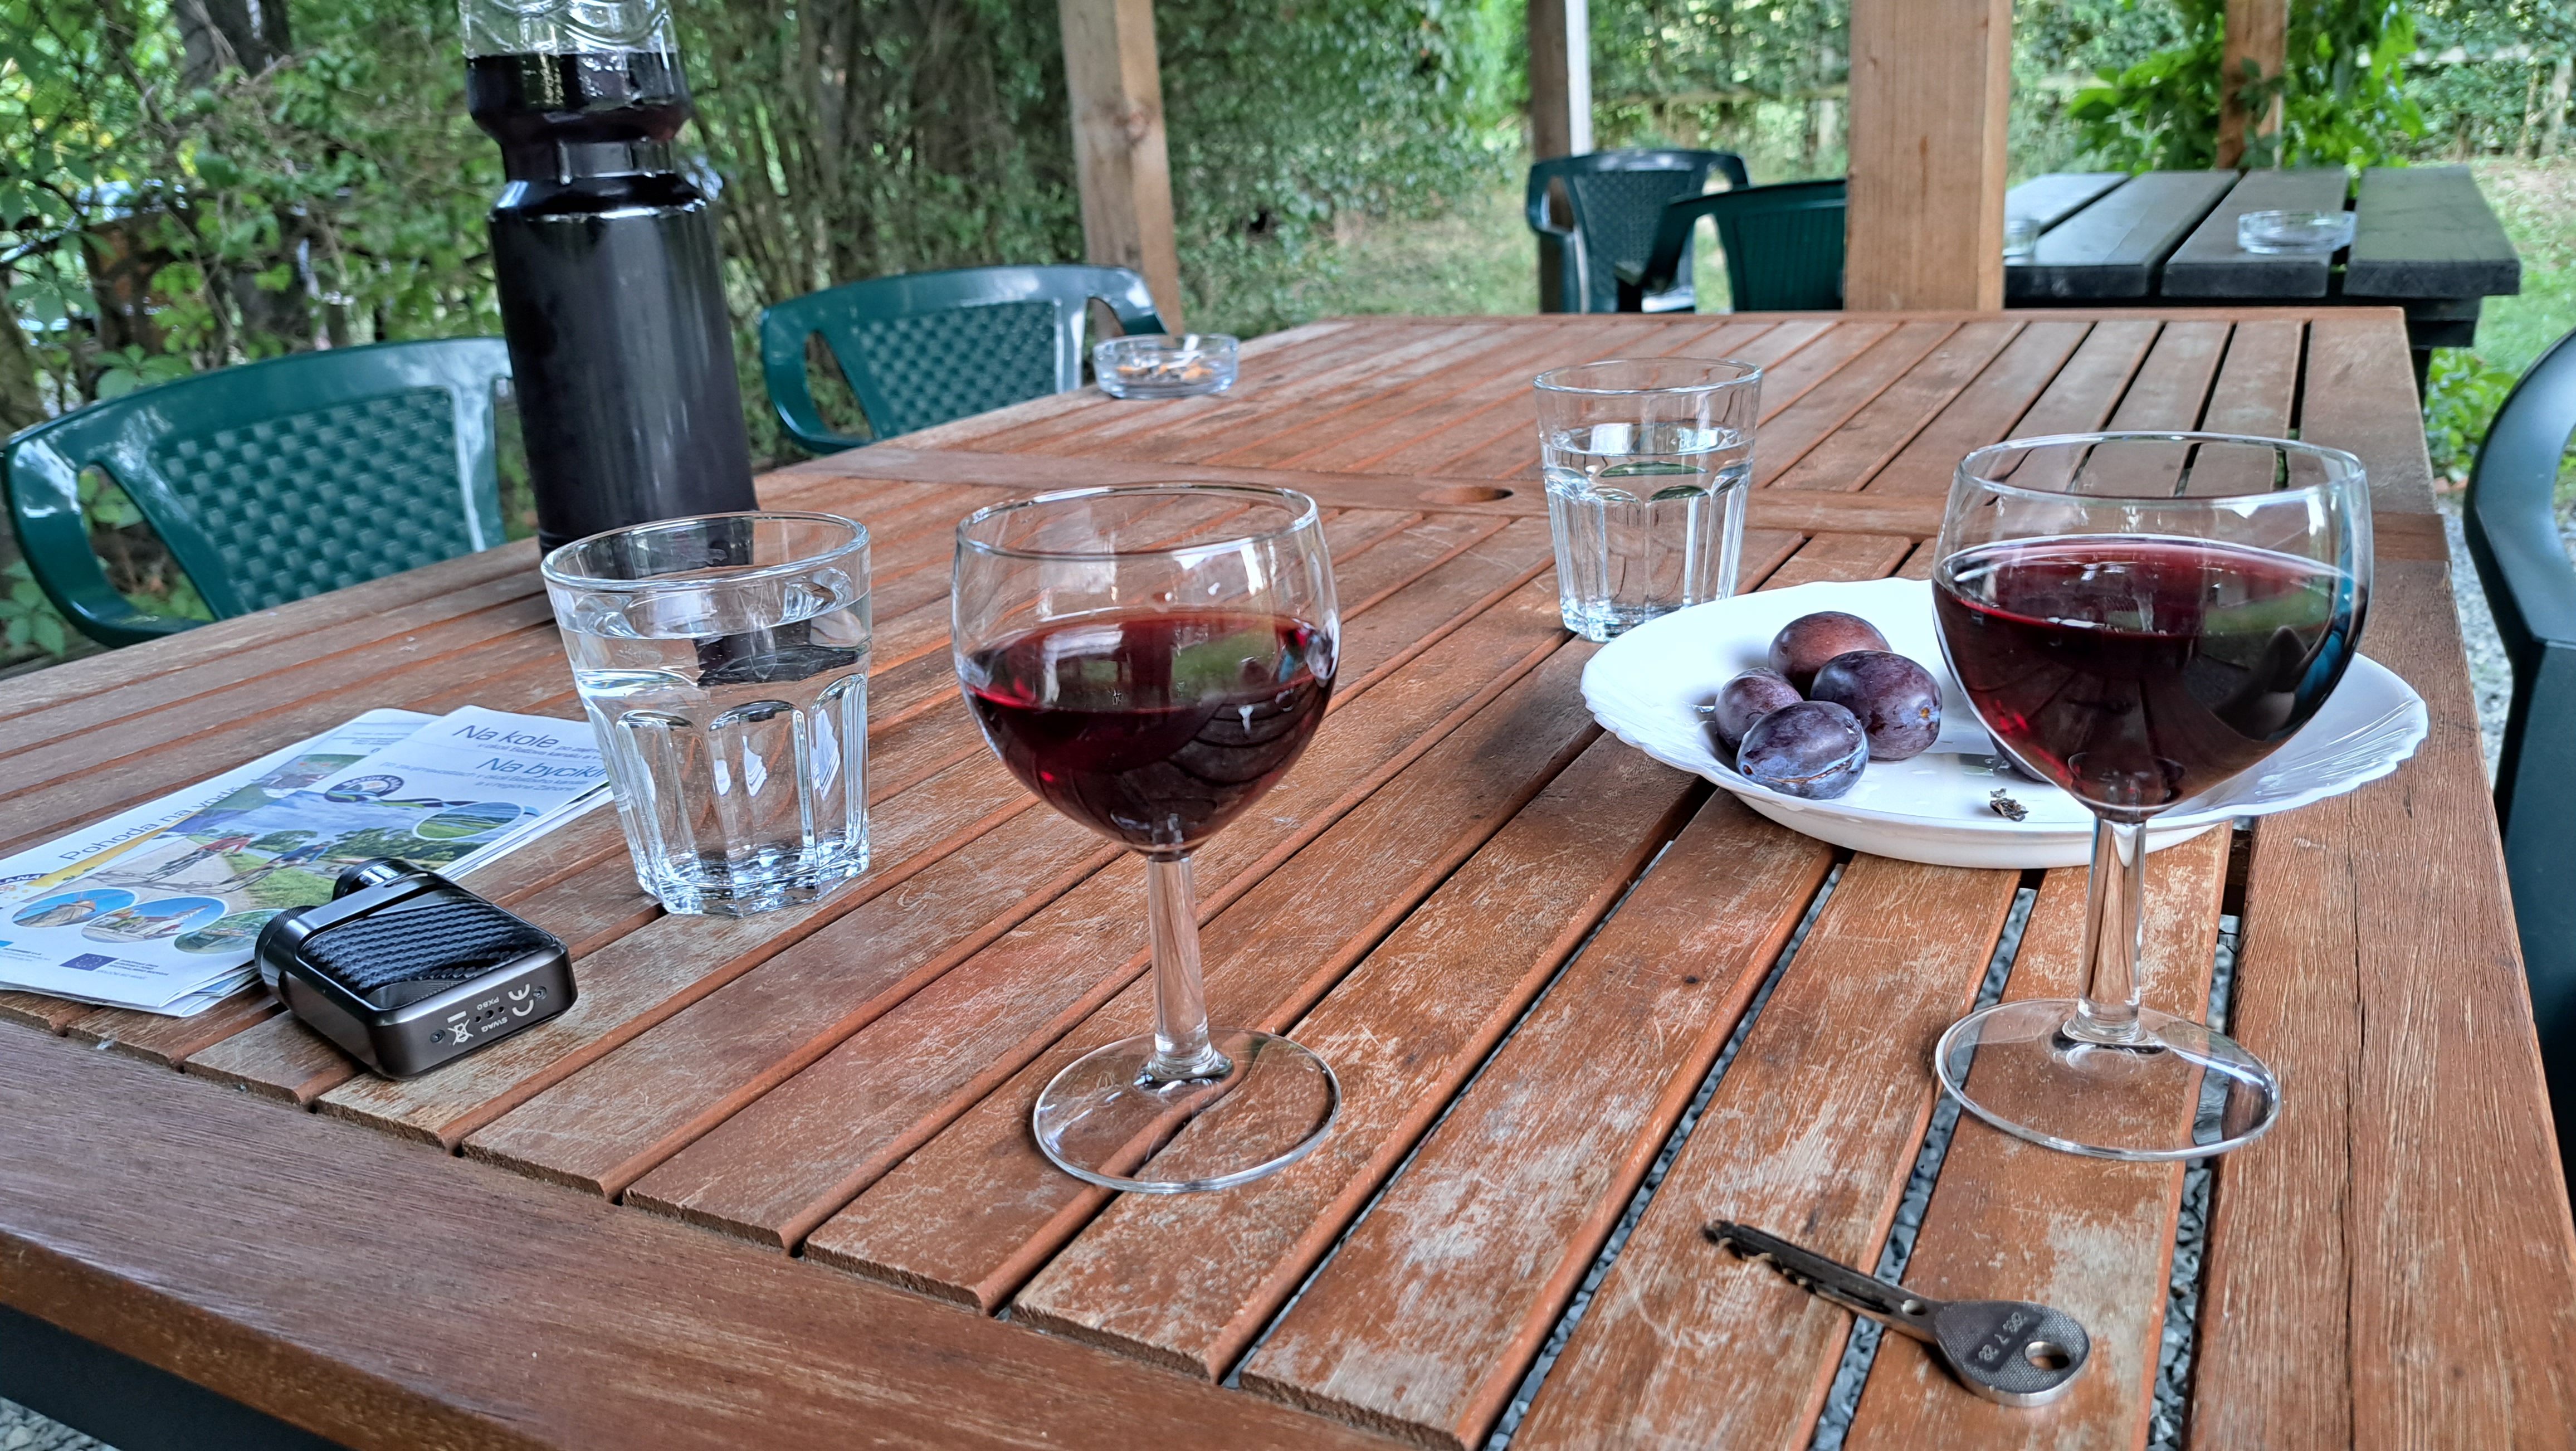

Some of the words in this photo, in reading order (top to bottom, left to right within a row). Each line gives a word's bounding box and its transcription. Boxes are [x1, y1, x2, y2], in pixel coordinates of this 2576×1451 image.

[452, 724, 499, 741] Na
[499, 731, 559, 748] kole
[476, 758, 524, 773] Na
[58, 823, 159, 861] Pohoda
[159, 809, 193, 822] na
[192, 786, 242, 810] vodě
[476, 996, 500, 1011] PX80
[481, 1016, 508, 1033] SWAG
